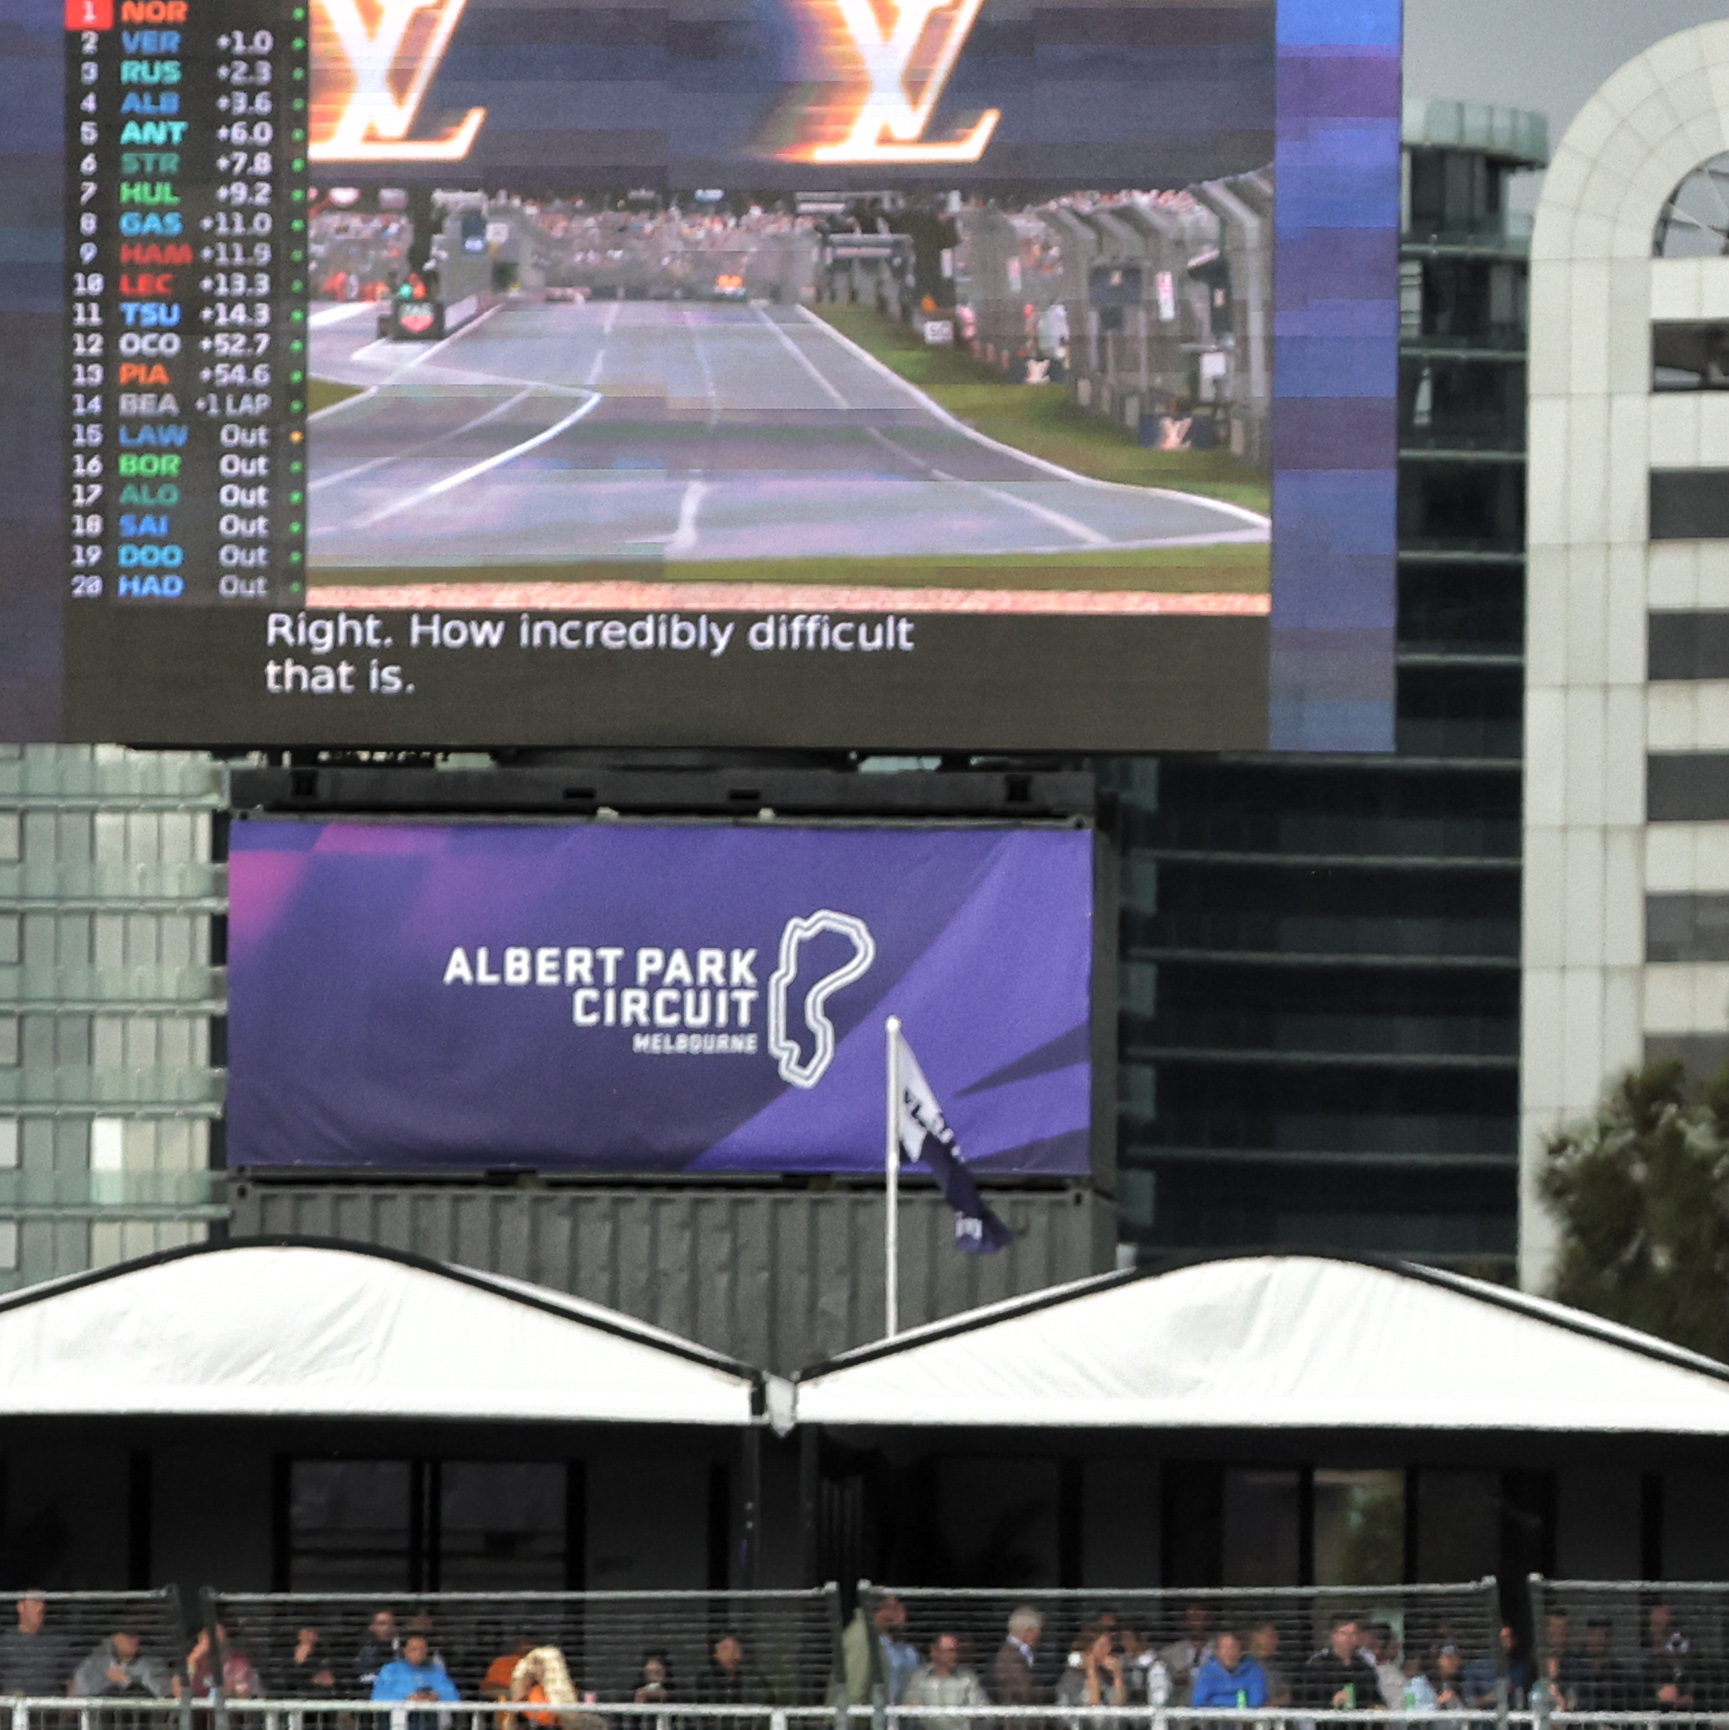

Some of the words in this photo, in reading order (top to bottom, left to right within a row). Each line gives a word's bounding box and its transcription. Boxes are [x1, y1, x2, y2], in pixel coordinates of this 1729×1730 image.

[122, 1, 188, 23] NOR
[80, 30, 98, 54] 2
[122, 30, 181, 54] VER
[216, 30, 273, 54] +1.0
[80, 60, 98, 84] 3
[121, 60, 181, 84] RUS
[216, 60, 273, 84] +2.3
[80, 91, 98, 115] 4
[121, 91, 180, 115] ALB
[216, 91, 273, 115] +3.6
[80, 121, 98, 145] 5
[121, 121, 188, 145] ANT
[216, 121, 273, 145] +6.0
[80, 152, 98, 175] 6
[122, 152, 180, 175] STR
[216, 152, 273, 175] +7.8
[80, 181, 98, 205] 7
[121, 181, 180, 205] HUL
[216, 181, 273, 205] +9.2
[80, 212, 98, 236] 8
[119, 212, 183, 236] GAS
[199, 212, 273, 236] +11.0
[80, 242, 98, 265] 9
[119, 242, 193, 265] HAM
[200, 242, 273, 265] +11.9
[72, 272, 104, 296] 10
[119, 272, 173, 296] LEC
[199, 272, 273, 296] +13.3
[72, 302, 104, 327] 11
[119, 302, 181, 327] TSU
[199, 302, 273, 327] +14.3
[72, 333, 104, 357] 12
[119, 333, 181, 357] OCO
[199, 333, 273, 357] +52.7
[72, 363, 104, 387] 13
[119, 363, 169, 387] PIA
[199, 363, 273, 387] +54.6
[72, 393, 104, 417] 14
[119, 393, 180, 417] BEA
[225, 393, 272, 417] LAP
[72, 423, 104, 447] 15
[118, 423, 188, 447] LAW
[220, 423, 270, 447] Out
[72, 453, 104, 477] 16
[118, 453, 182, 477] BOR
[219, 453, 270, 477] Out
[72, 484, 104, 508] 17
[119, 484, 180, 508] ALO
[219, 484, 270, 508] Out
[72, 514, 104, 538] 18
[118, 514, 169, 538] SAI
[219, 514, 270, 538] Out
[72, 545, 104, 568] 19
[118, 545, 184, 568] DOO
[219, 545, 270, 568] Out
[72, 575, 104, 598] 20
[118, 575, 185, 598] HAD
[219, 575, 270, 598] Out
[267, 611, 393, 654] Right.
[410, 612, 505, 648] How
[520, 612, 735, 657] incredibly
[748, 614, 915, 651] difficult
[266, 658, 356, 693] that
[370, 658, 415, 693] is.
[443, 946, 624, 986] ALBERT
[636, 947, 758, 987] PARK
[573, 986, 758, 1028] CIRCUIT
[633, 1033, 758, 1054] MELBOURNE
